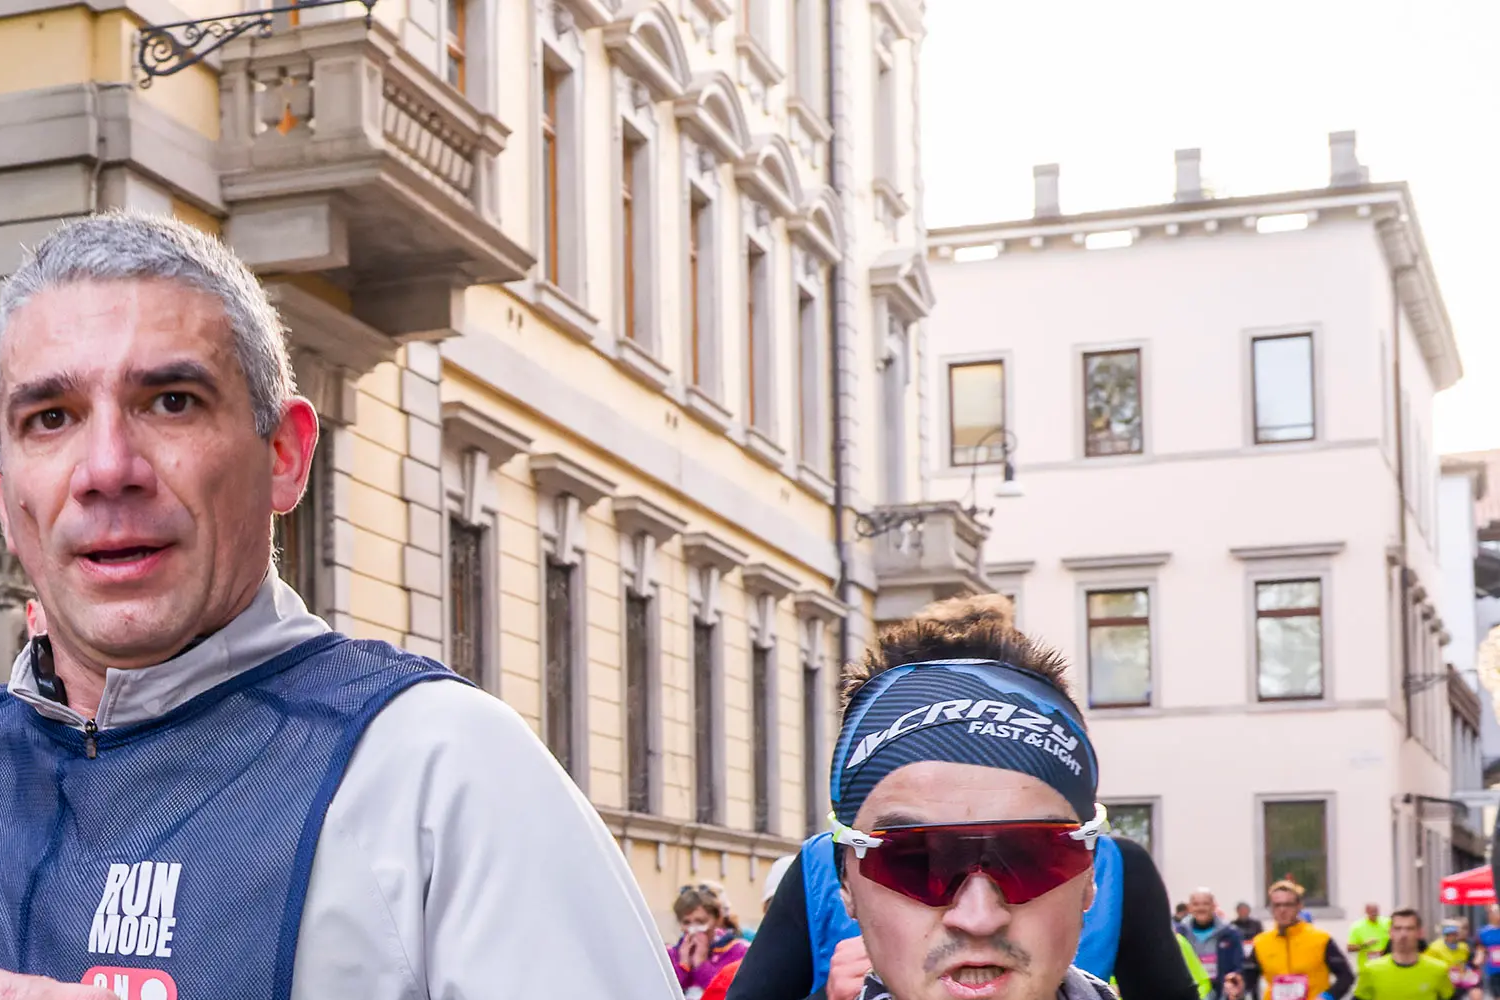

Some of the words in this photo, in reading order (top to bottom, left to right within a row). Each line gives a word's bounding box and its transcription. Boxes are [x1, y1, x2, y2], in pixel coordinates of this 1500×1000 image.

[887, 698, 1079, 753] CRAZY
[95, 860, 183, 918] RUN
[87, 913, 177, 958] MODE
